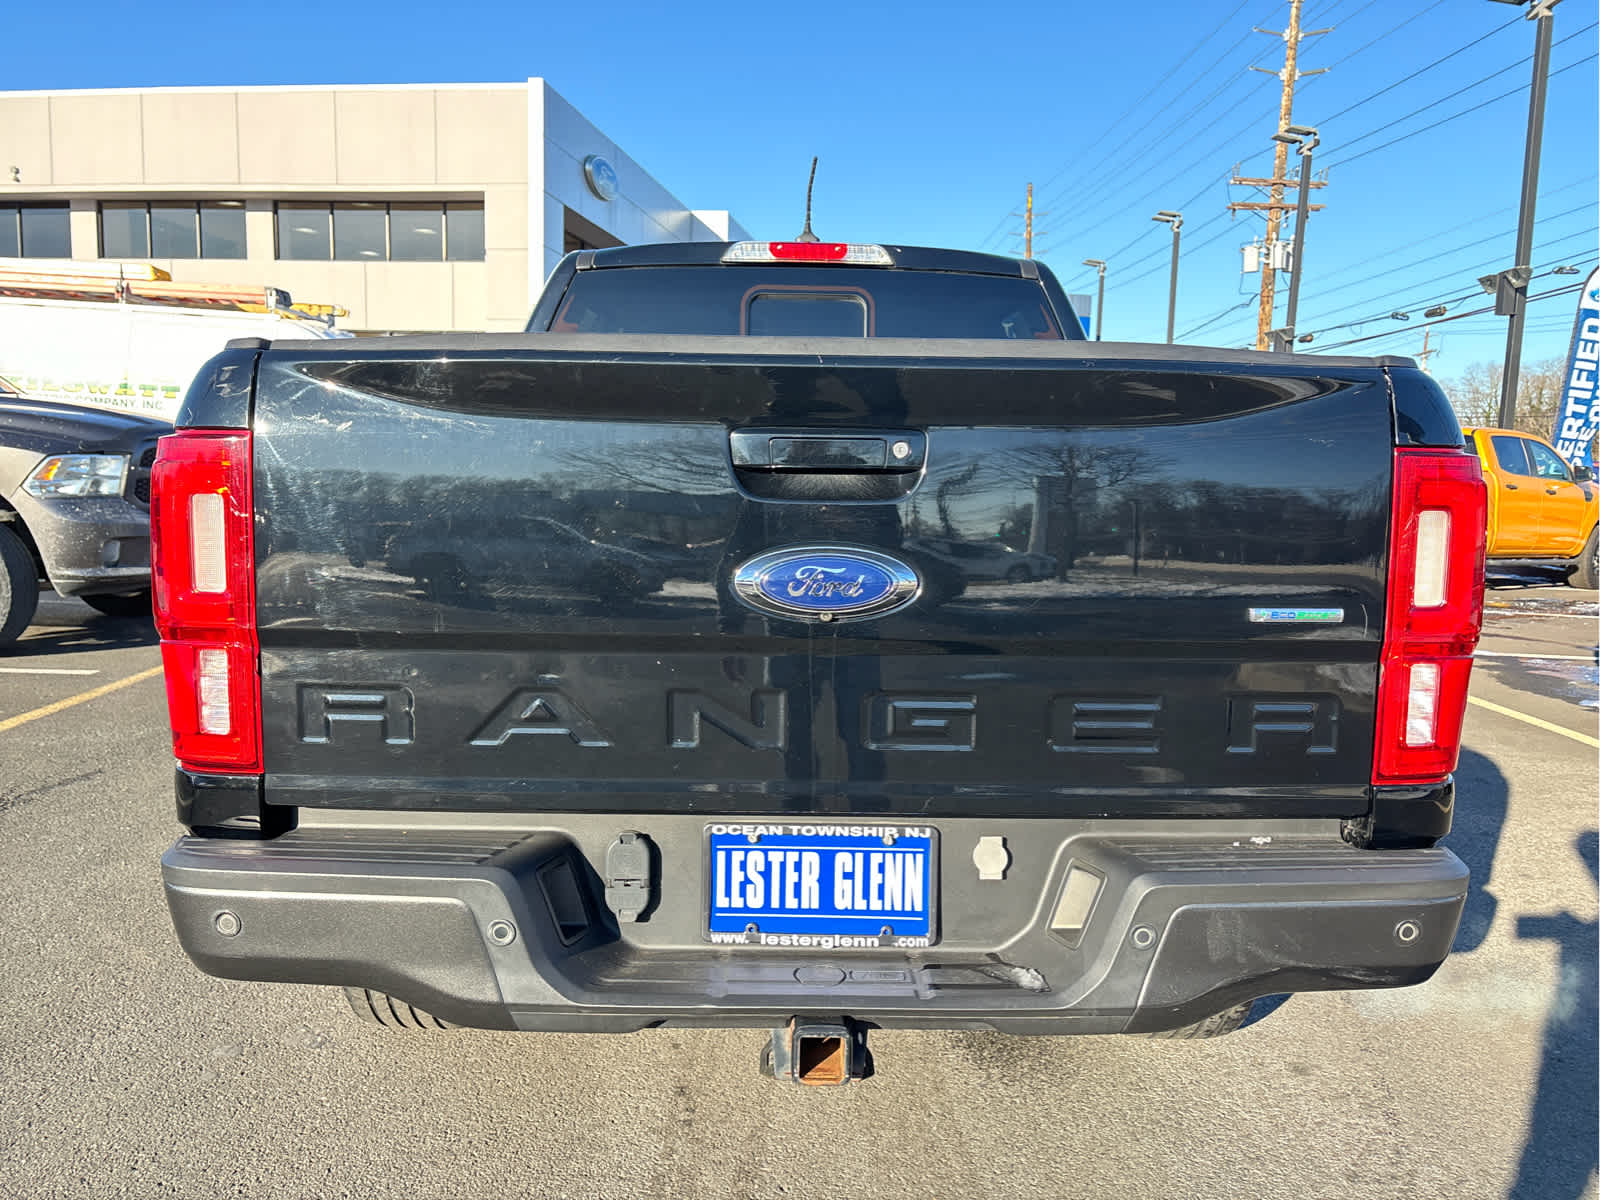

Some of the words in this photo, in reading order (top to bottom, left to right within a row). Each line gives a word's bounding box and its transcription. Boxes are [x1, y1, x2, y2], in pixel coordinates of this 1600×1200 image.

[1556, 318, 1599, 459] ERTIFIED
[787, 565, 864, 598] Ford
[297, 681, 1342, 754] RANGER
[711, 824, 783, 836] OCEAN
[905, 826, 931, 838] NJ
[715, 850, 821, 909] LESTER
[833, 851, 925, 912] GLENN
[760, 934, 880, 949] lesterglenn
